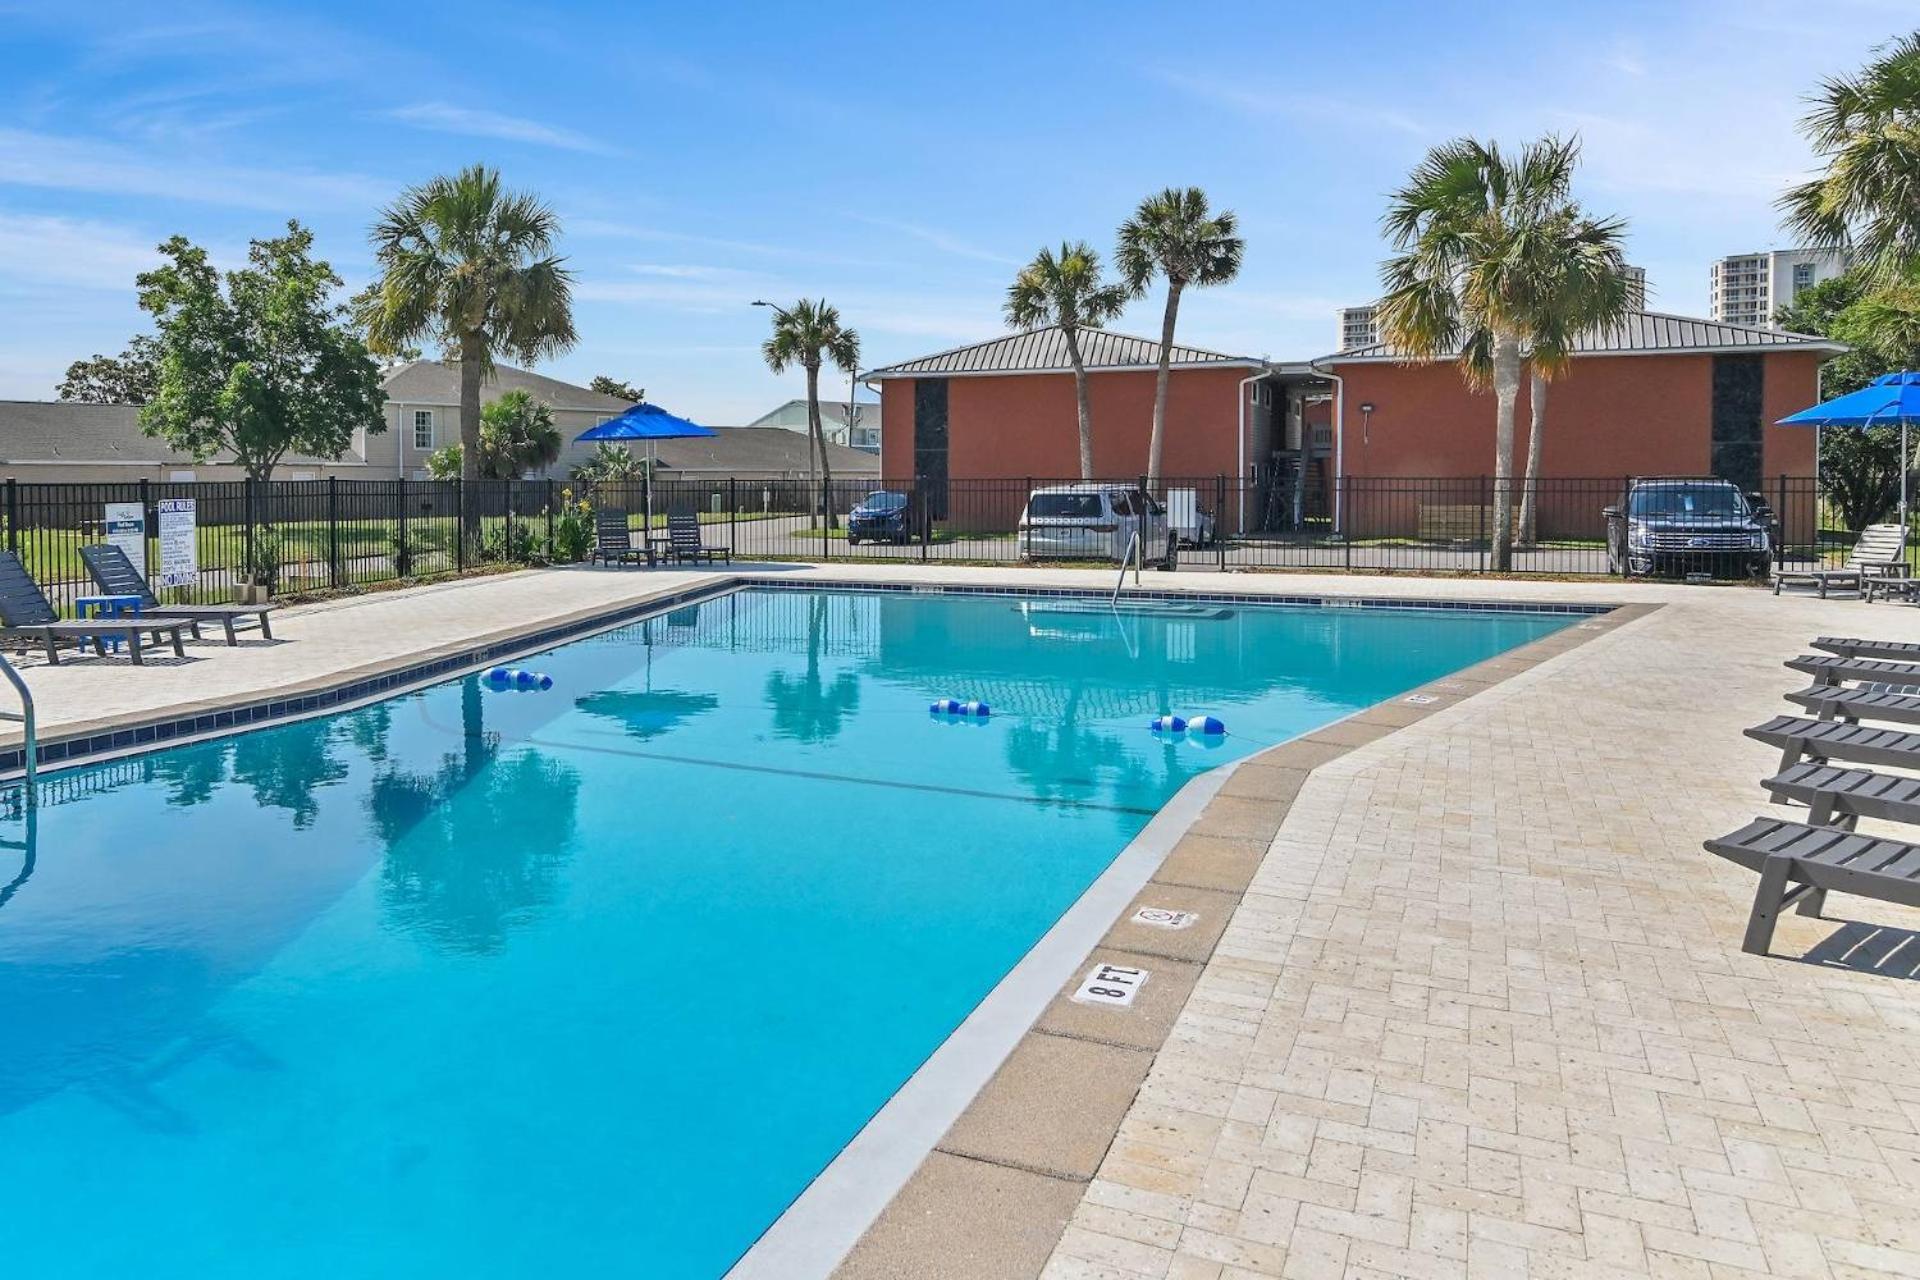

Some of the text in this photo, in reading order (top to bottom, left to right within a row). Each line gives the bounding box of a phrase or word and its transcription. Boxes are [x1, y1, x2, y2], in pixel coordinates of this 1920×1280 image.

[161, 501, 195, 512] POOL RULES
[164, 572, 195, 585] NO DIVING
[1088, 966, 1139, 998] 8 FT
